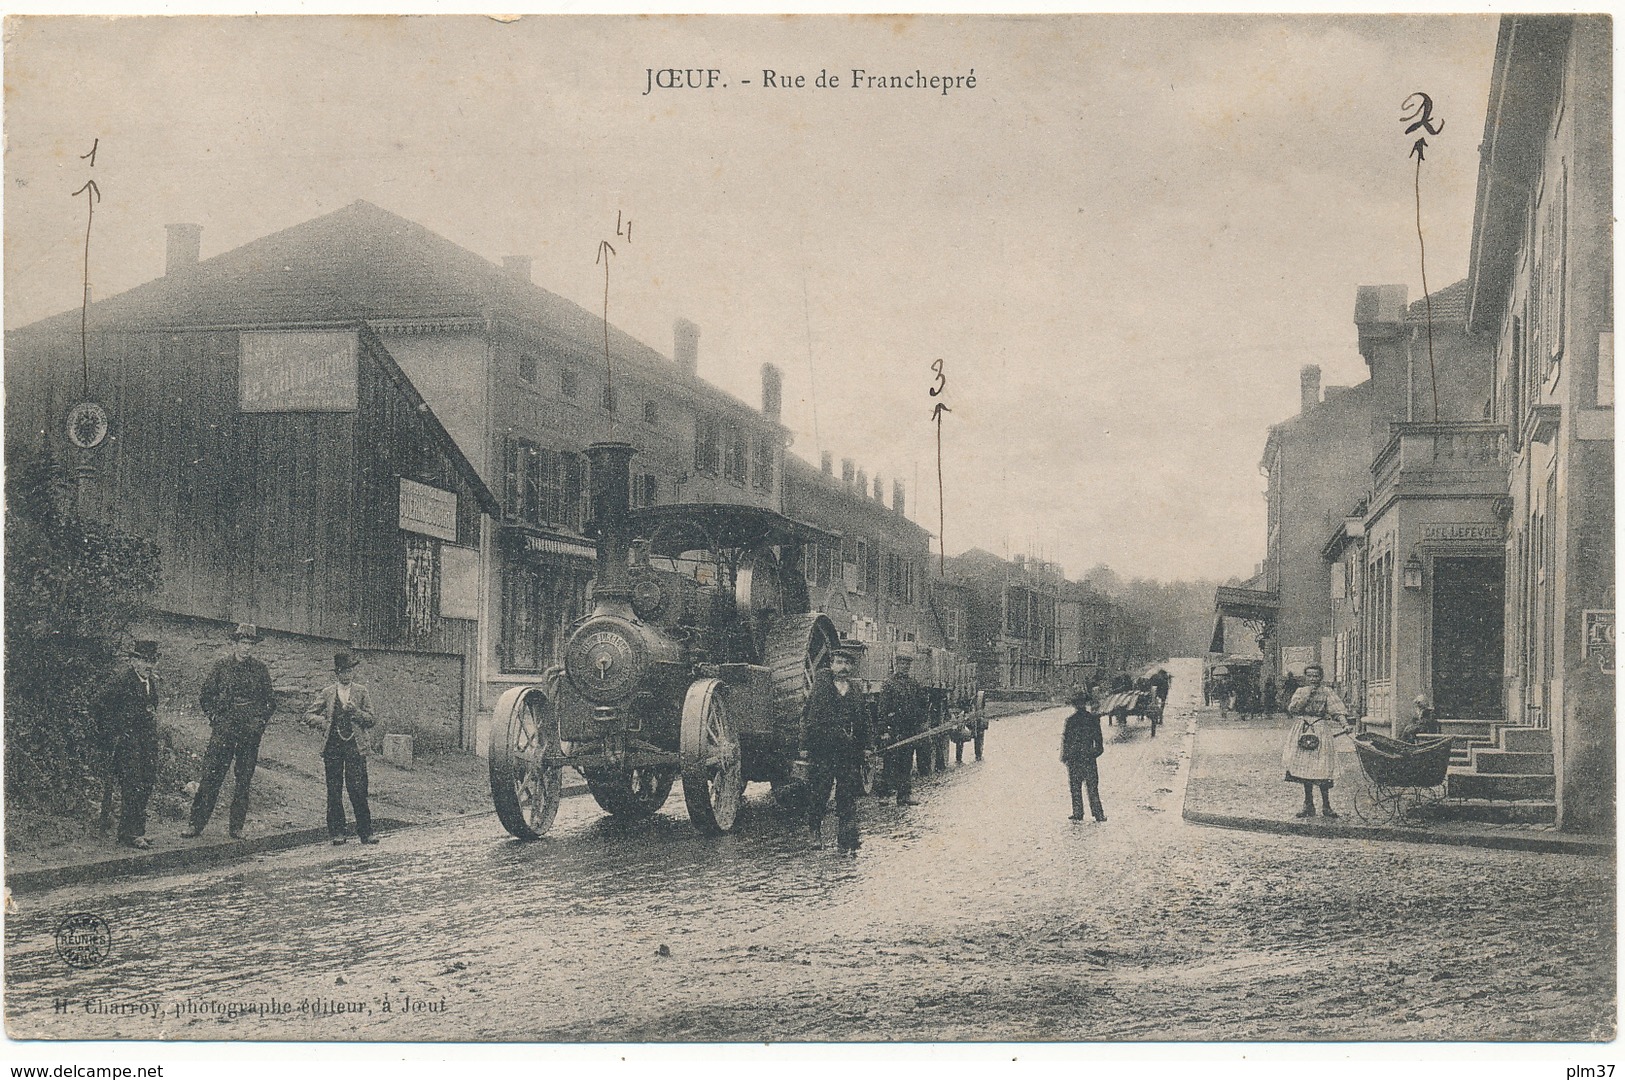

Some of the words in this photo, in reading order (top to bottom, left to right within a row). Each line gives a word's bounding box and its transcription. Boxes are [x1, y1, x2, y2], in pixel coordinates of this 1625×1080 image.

[642, 68, 728, 95] JŒUF.
[762, 69, 806, 89] Rue
[815, 70, 840, 89] de
[851, 68, 977, 96] Franchepré
[1399, 91, 1445, 136] 2
[79, 137, 99, 168] 1
[929, 358, 946, 397] 3
[53, 999, 75, 1015] H.
[84, 998, 166, 1019] Charroy,
[175, 998, 292, 1018] photographe
[301, 998, 373, 1017] éditeur,
[382, 993, 393, 1013] à
